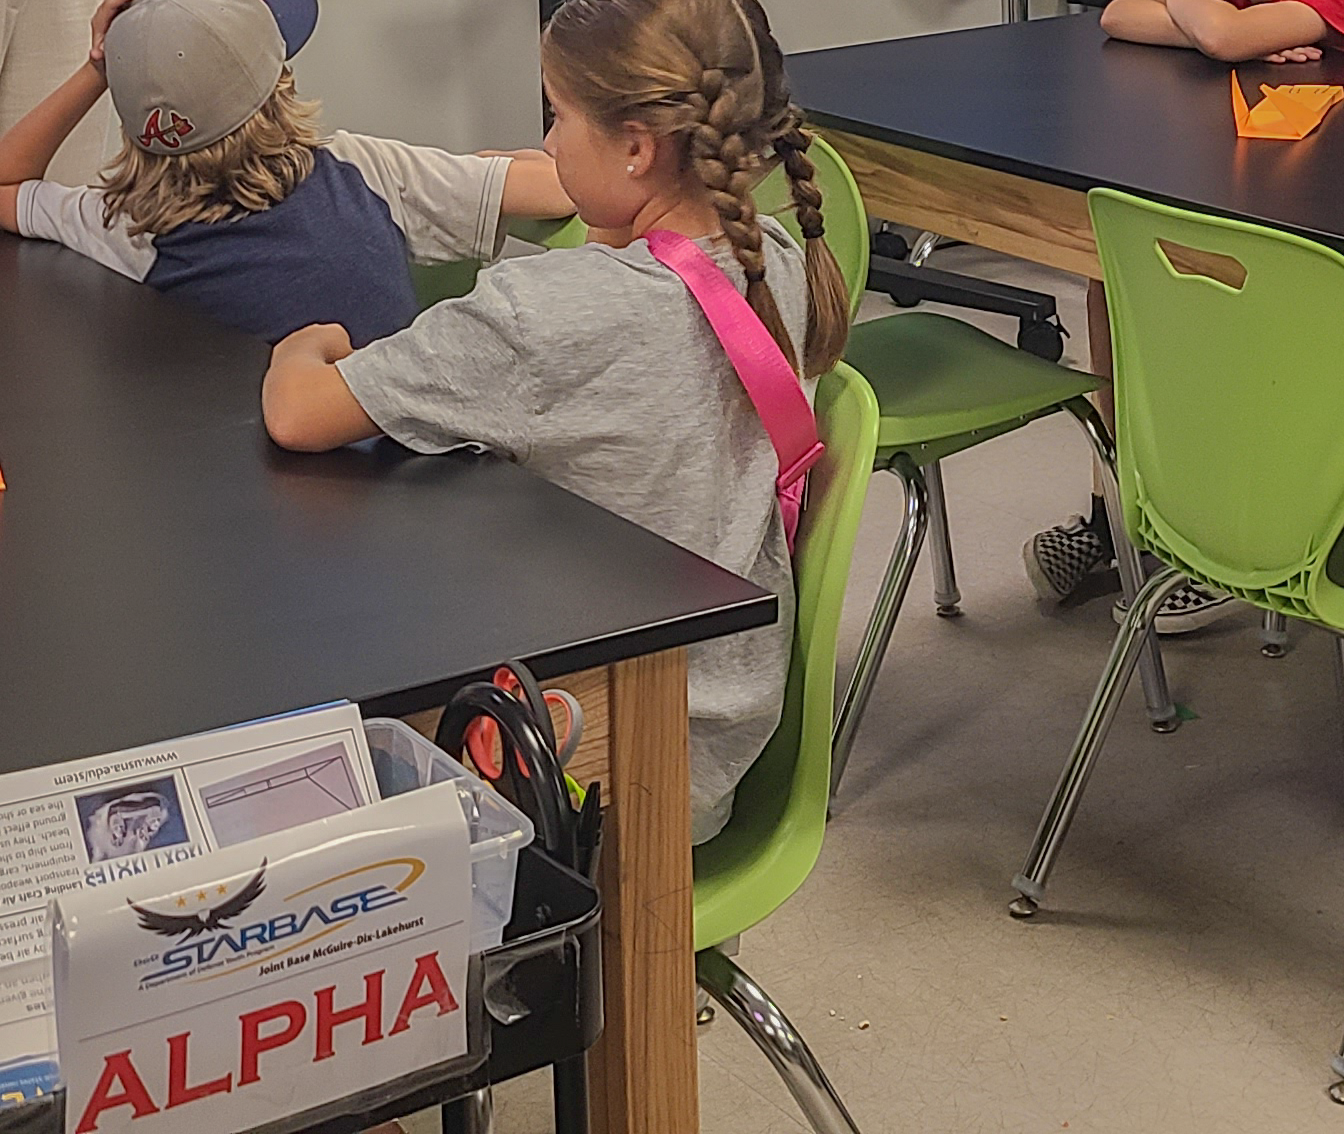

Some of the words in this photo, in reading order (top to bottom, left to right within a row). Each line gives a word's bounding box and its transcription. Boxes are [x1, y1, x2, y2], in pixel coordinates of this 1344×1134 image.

[54, 751, 178, 785] www.usna.edu/stem
[3, 895, 16, 904] Air
[19, 890, 43, 901] Craft
[45, 880, 83, 895] Landing
[139, 885, 408, 981] STARBASE
[259, 957, 285, 976] Joint
[287, 950, 311, 970] Base
[313, 916, 425, 960] McGuire-Dix-Lakehurst
[75, 951, 459, 1134] ALPHA
